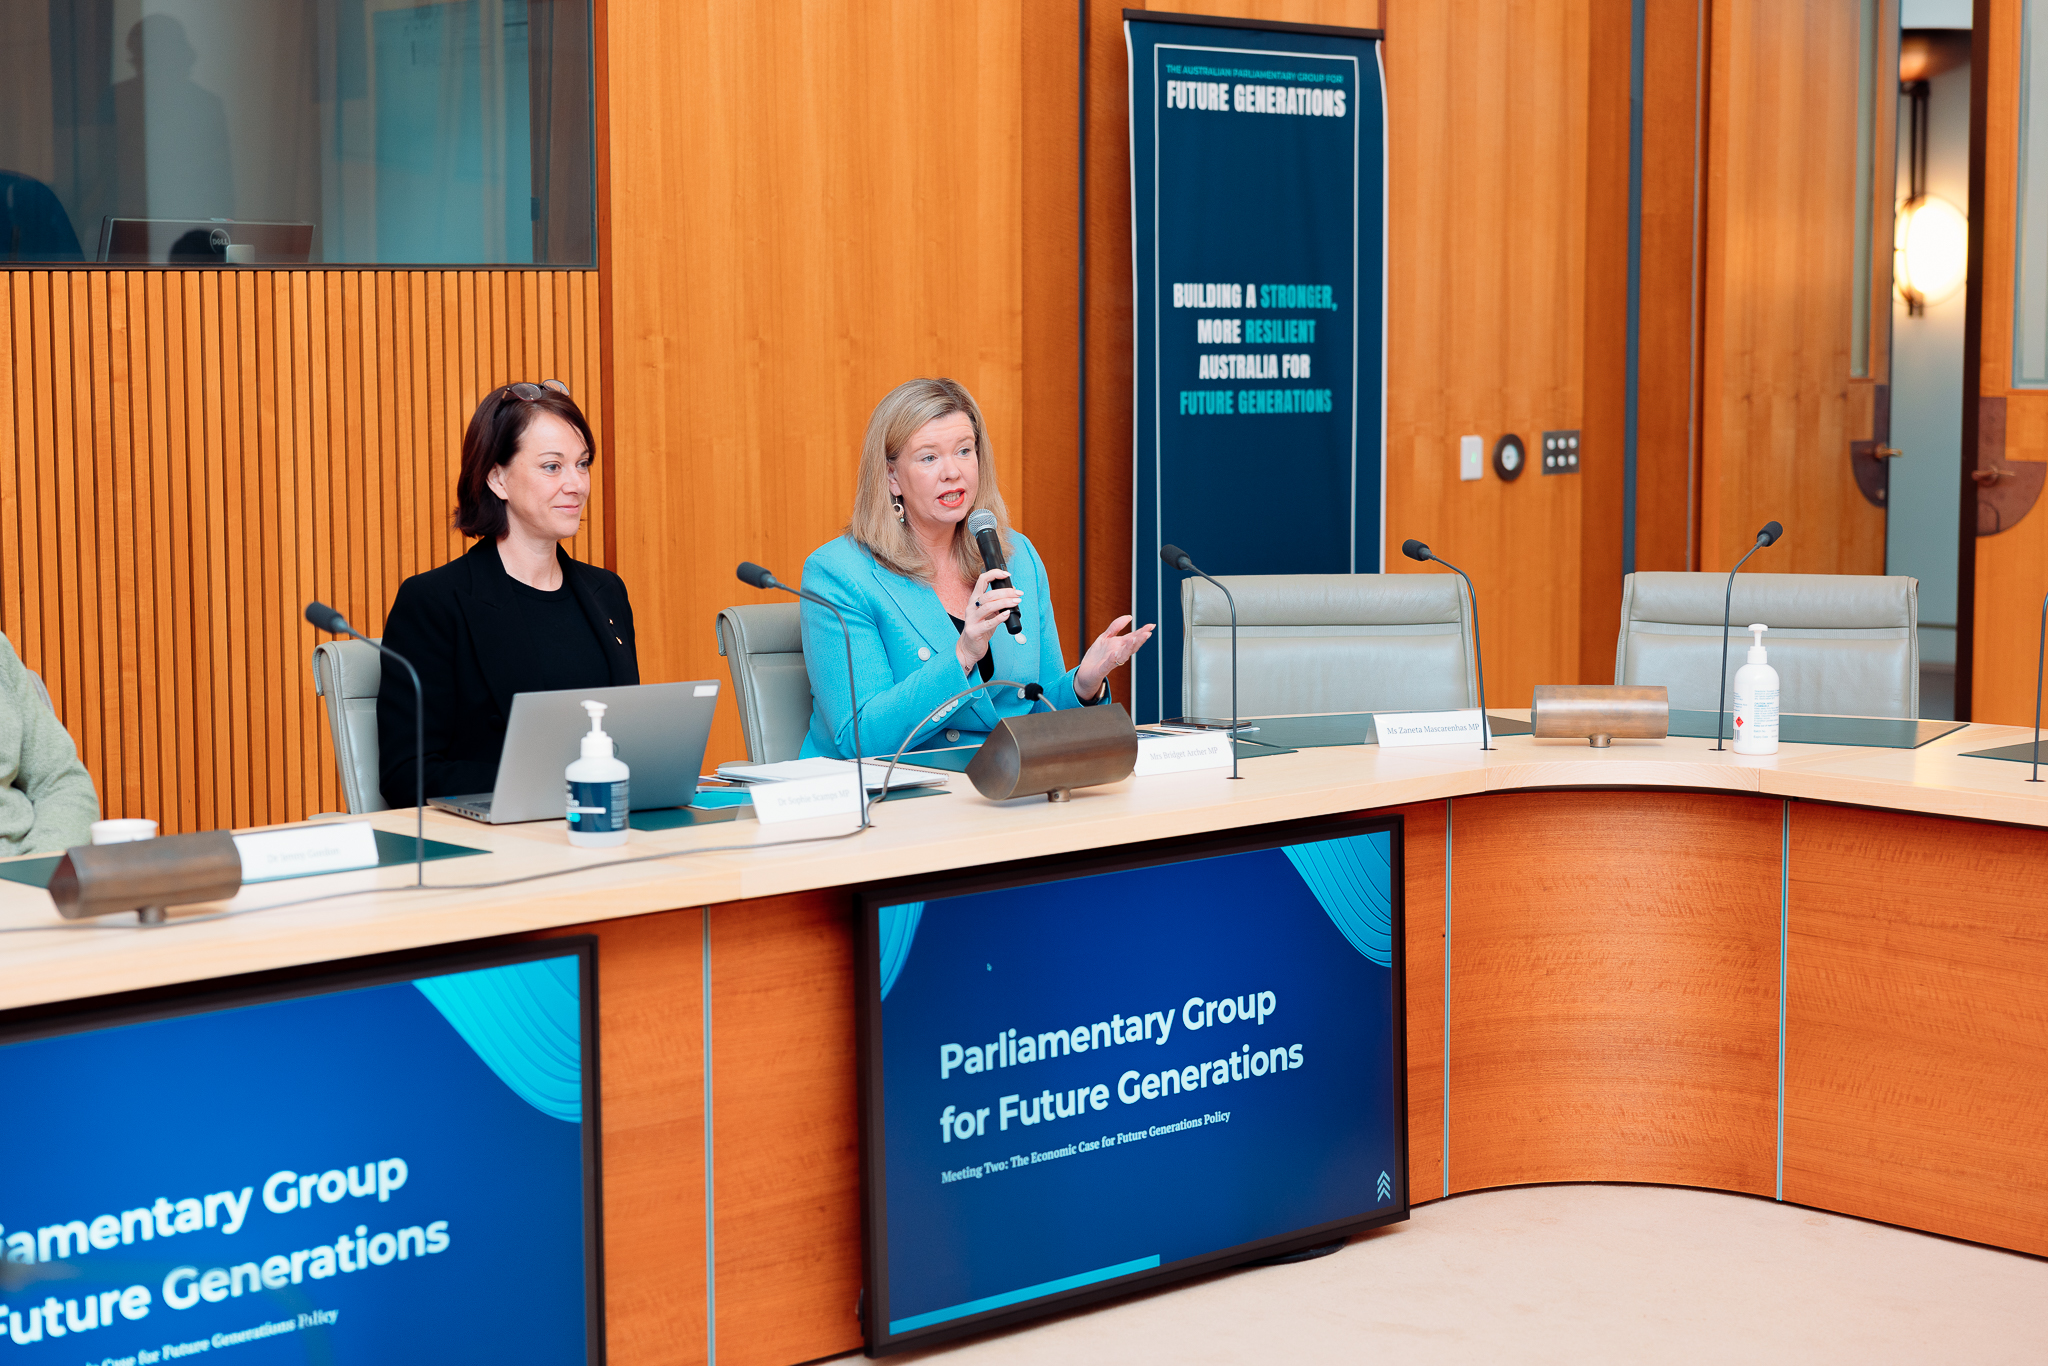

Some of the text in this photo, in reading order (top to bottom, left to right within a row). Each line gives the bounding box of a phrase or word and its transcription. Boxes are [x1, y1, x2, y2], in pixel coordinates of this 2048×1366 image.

[1166, 64, 1344, 84] THE AUSTRALIAN PARLIAMENTARY GROUP FOR
[1166, 80, 1347, 118] FUTURE GENERATIONS
[1173, 283, 1338, 311] BUILDING A STRONGER,
[1197, 319, 1316, 344] MORE RESILIENT
[1199, 354, 1311, 379] AUSTRALIA FOR
[1179, 389, 1332, 415] FUTURE GENERATIONS
[1387, 727, 1398, 735] Ms
[1423, 724, 1467, 733] Mascarenhas
[1468, 723, 1480, 731] MP
[1163, 751, 1186, 759] Bridget
[1187, 748, 1207, 757] Archer
[1207, 746, 1218, 754] MP
[838, 789, 850, 798] MP
[940, 990, 1277, 1079] Parliamentary Group
[939, 1043, 1304, 1143] for Future Generations
[941, 1110, 1231, 1184] Meeting Two: The Economic Case for Future Generations Policy
[262, 1157, 409, 1214] Group
[162, 1220, 450, 1311] Generations
[137, 1348, 161, 1366] for
[161, 1338, 210, 1361] Future
[211, 1319, 297, 1349] Generations
[297, 1308, 339, 1330] Policy
